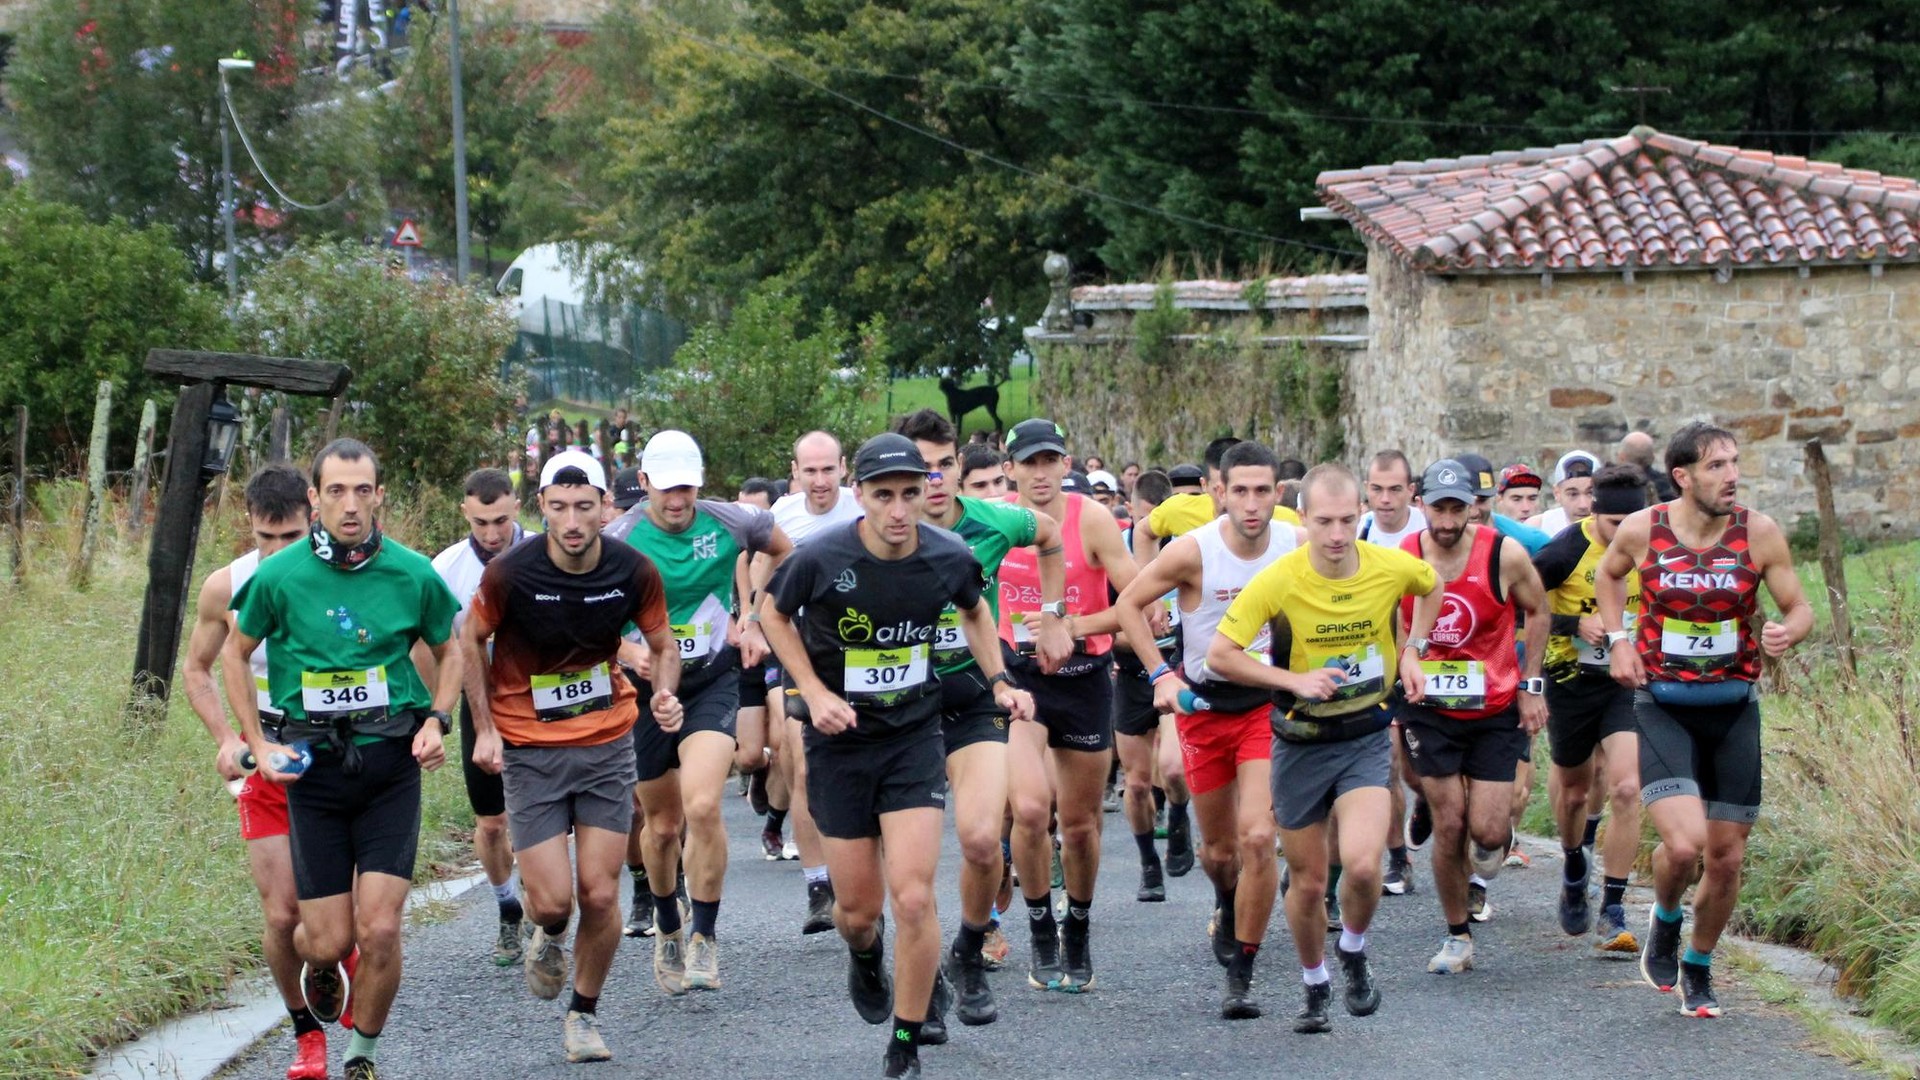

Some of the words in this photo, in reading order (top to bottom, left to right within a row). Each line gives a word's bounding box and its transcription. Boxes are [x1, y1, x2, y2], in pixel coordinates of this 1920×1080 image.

[1659, 573, 1738, 588] KENYA
[1316, 620, 1372, 634] GAIKAR
[1686, 636, 1714, 650] 74
[865, 664, 910, 685] 307
[1431, 675, 1468, 690] 178
[321, 685, 368, 705] 346
[551, 680, 593, 701] 188
